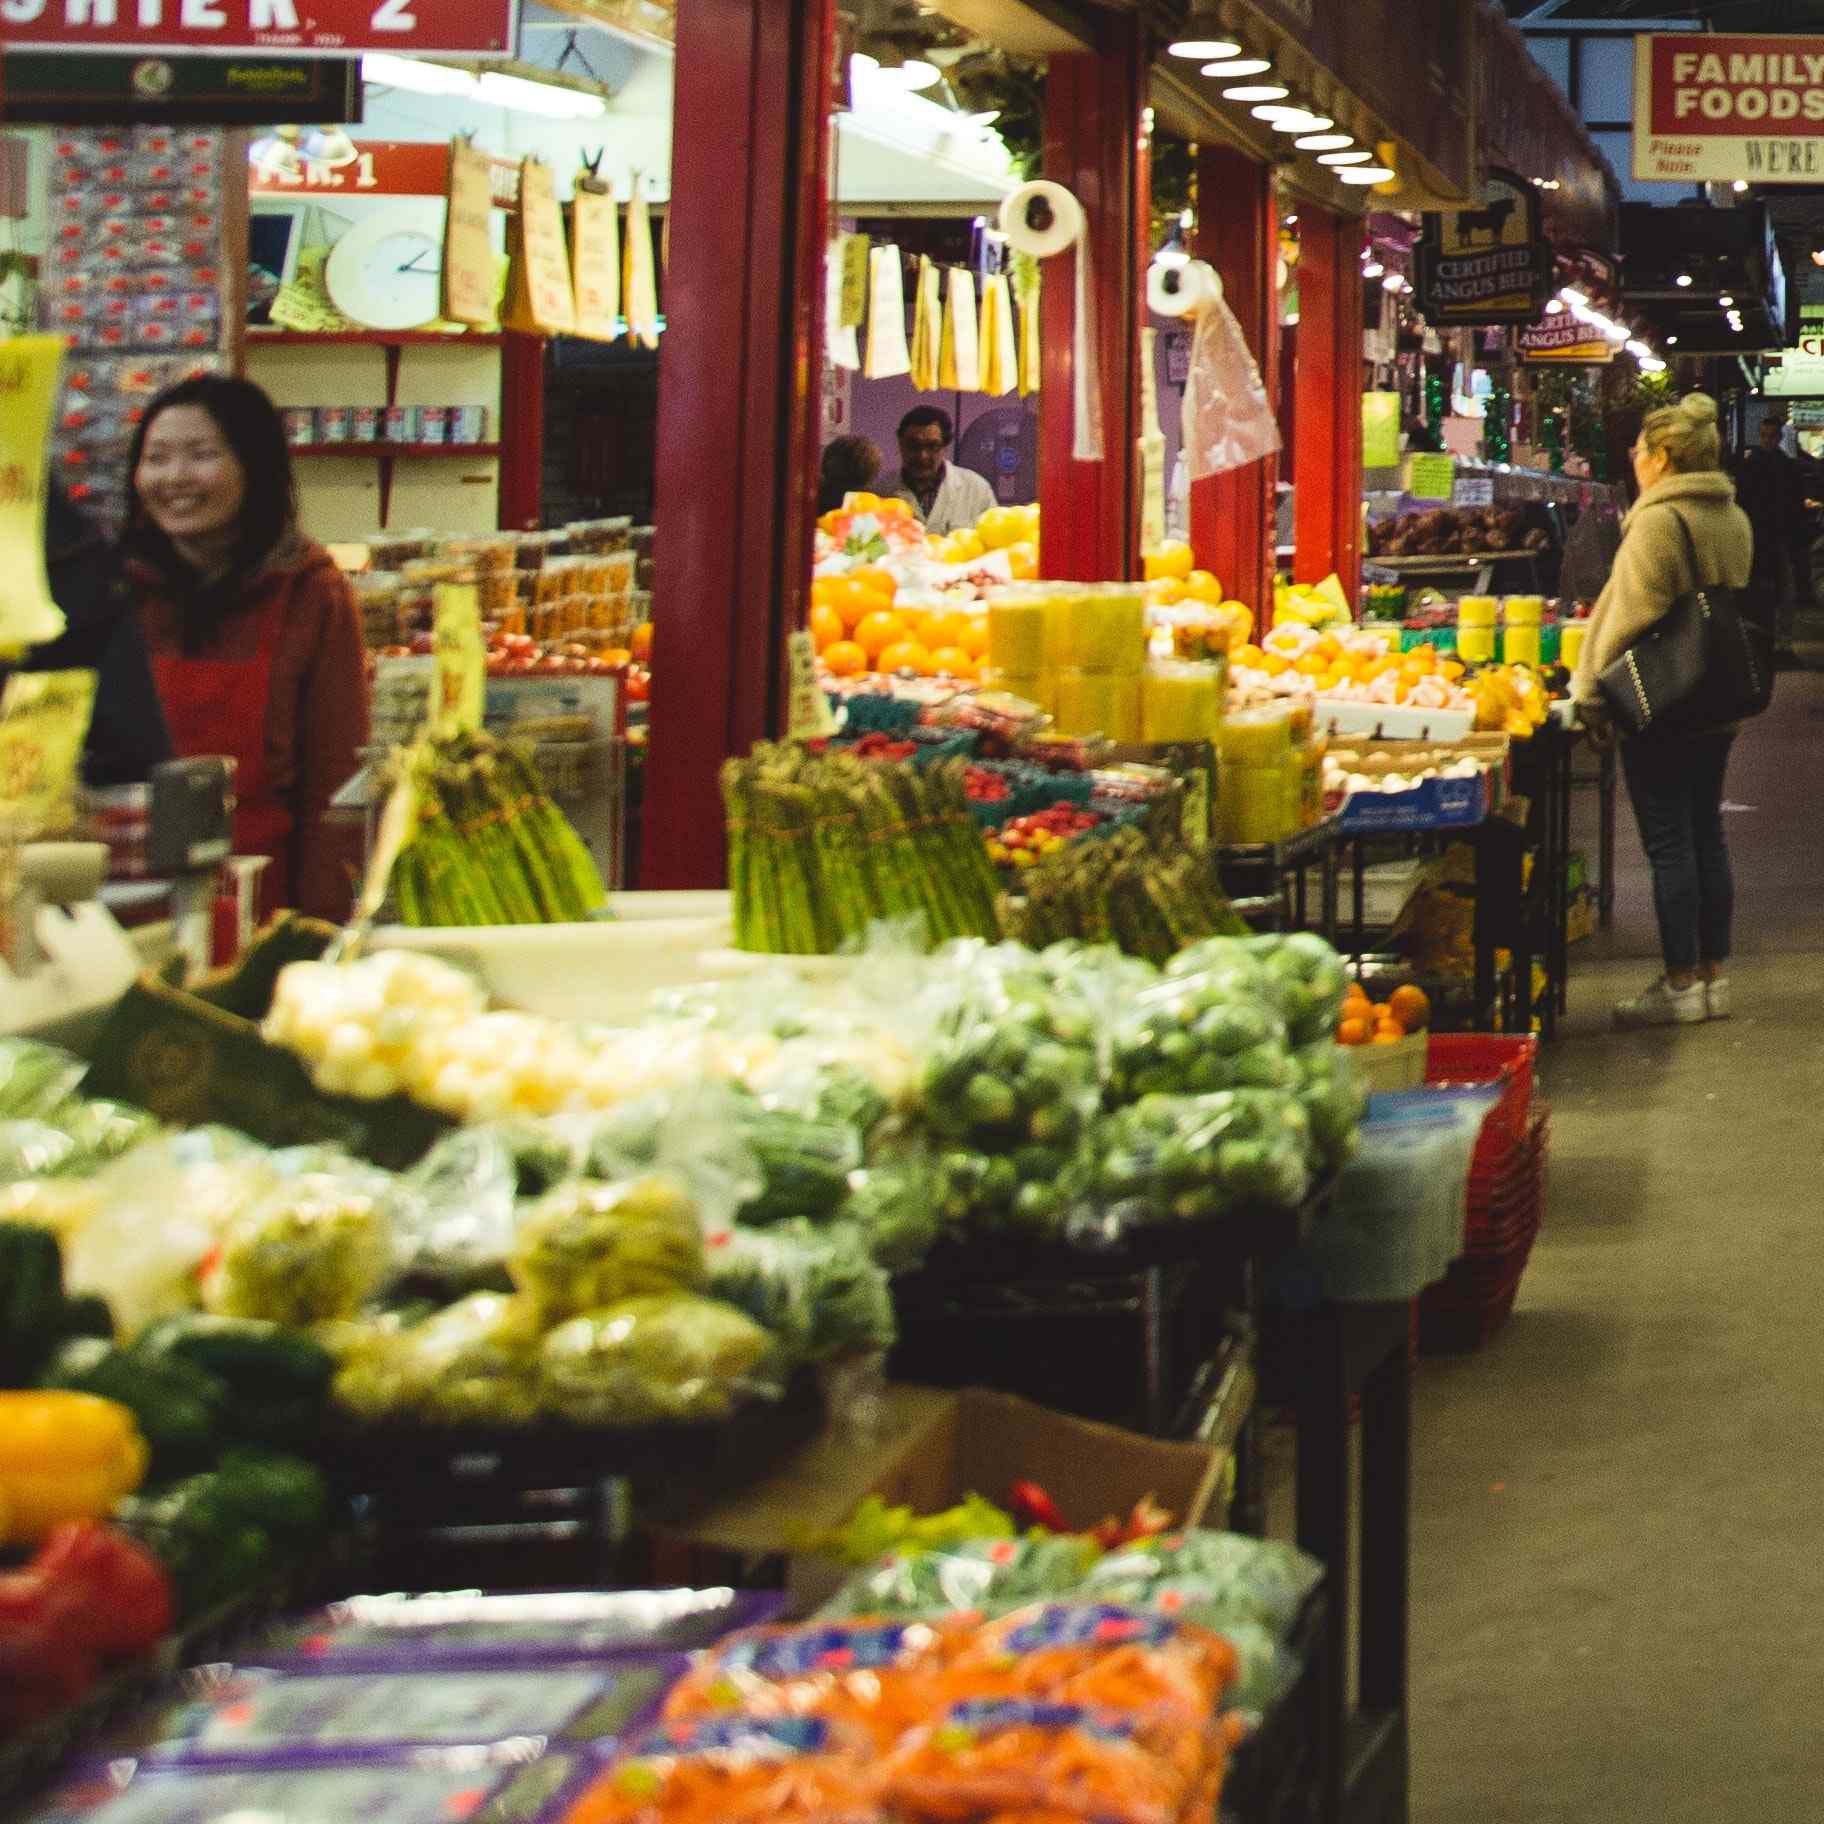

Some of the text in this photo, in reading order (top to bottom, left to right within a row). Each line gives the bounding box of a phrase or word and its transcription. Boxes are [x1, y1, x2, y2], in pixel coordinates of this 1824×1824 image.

[1744, 140, 1816, 174] WE'RE
[1436, 249, 1531, 279] CERTIFIED
[1430, 275, 1498, 300] ANGUS
[1520, 326, 1575, 347] ANGUS
